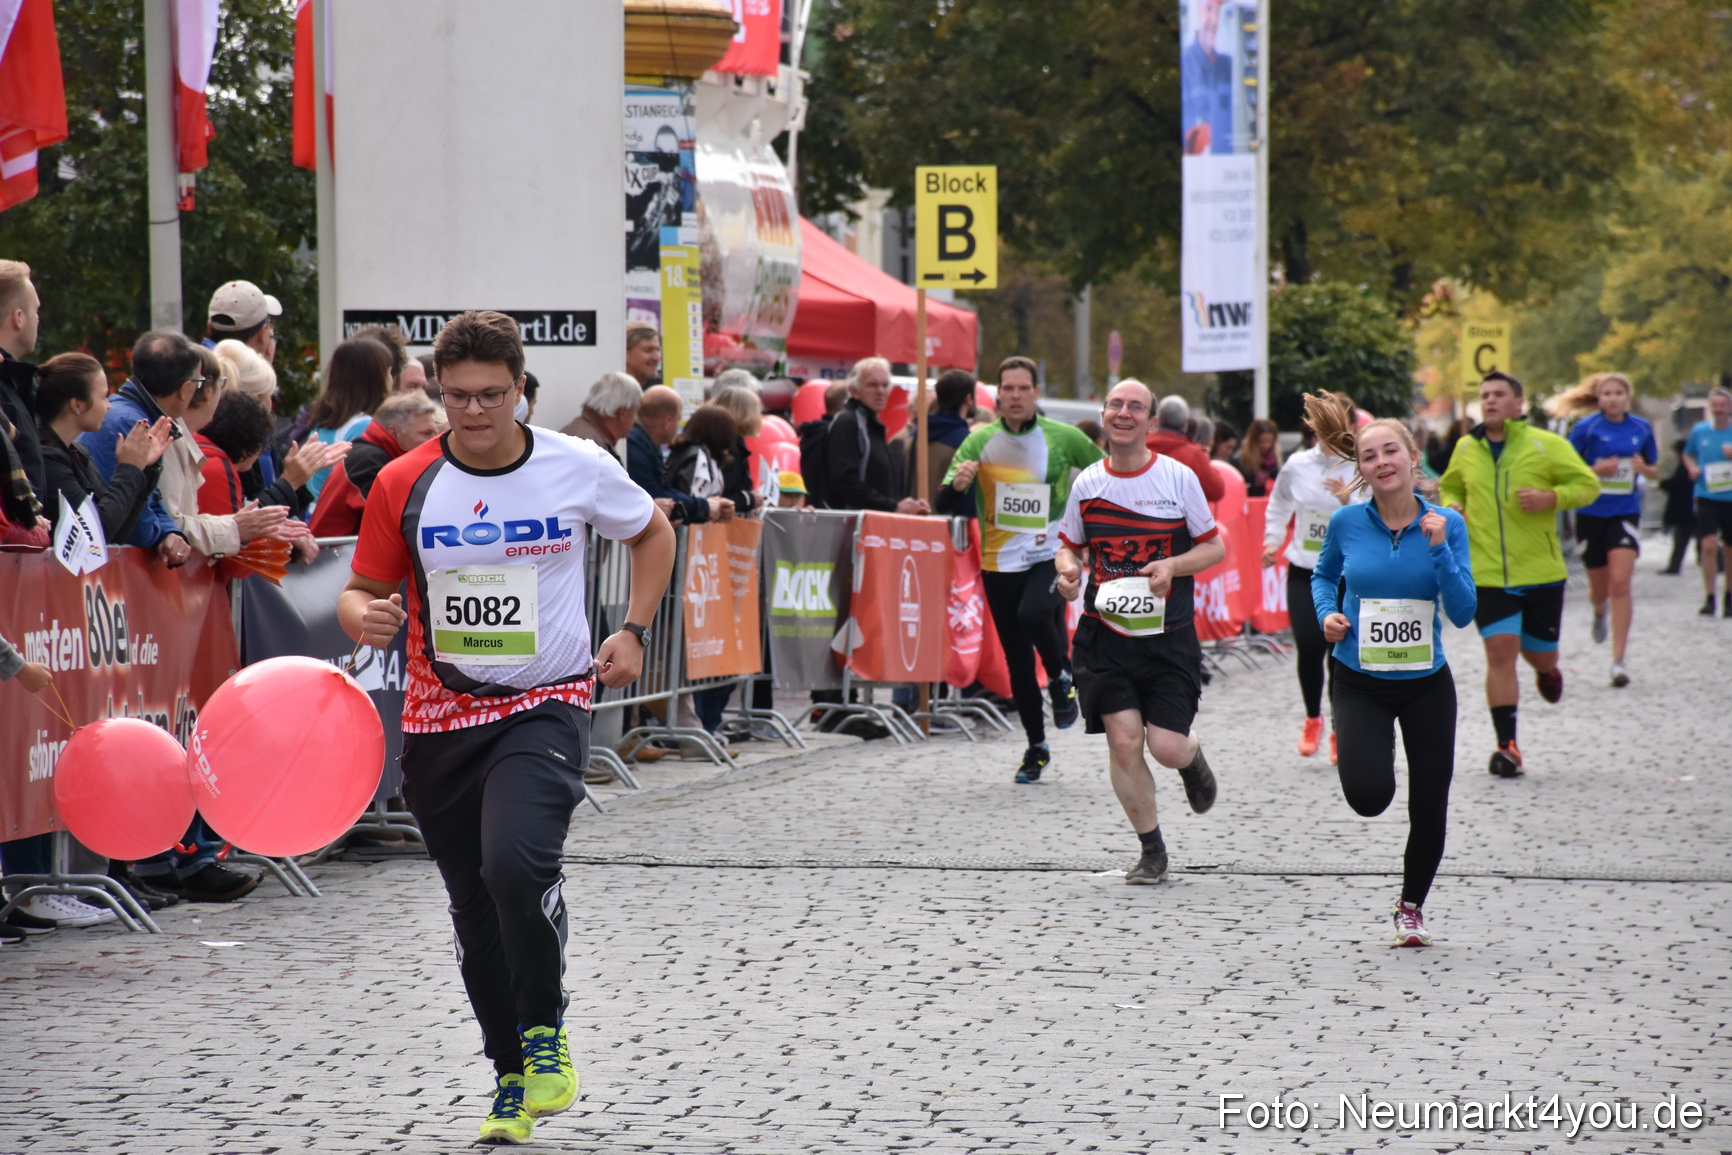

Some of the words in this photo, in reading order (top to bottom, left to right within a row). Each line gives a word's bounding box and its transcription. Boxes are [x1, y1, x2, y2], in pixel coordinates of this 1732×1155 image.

[926, 172, 987, 194] Block
[937, 204, 976, 262] B
[1474, 344, 1497, 377] C
[1003, 497, 1041, 514] 5500
[62, 525, 79, 562] swn
[505, 536, 572, 557] energie
[469, 574, 505, 583] BOCK
[772, 566, 834, 612] BOCK
[446, 596, 521, 626] 5082
[1105, 596, 1154, 614] 5225
[463, 637, 503, 648] Marcus
[1370, 620, 1421, 643] 5086
[1387, 651, 1408, 659] Clara
